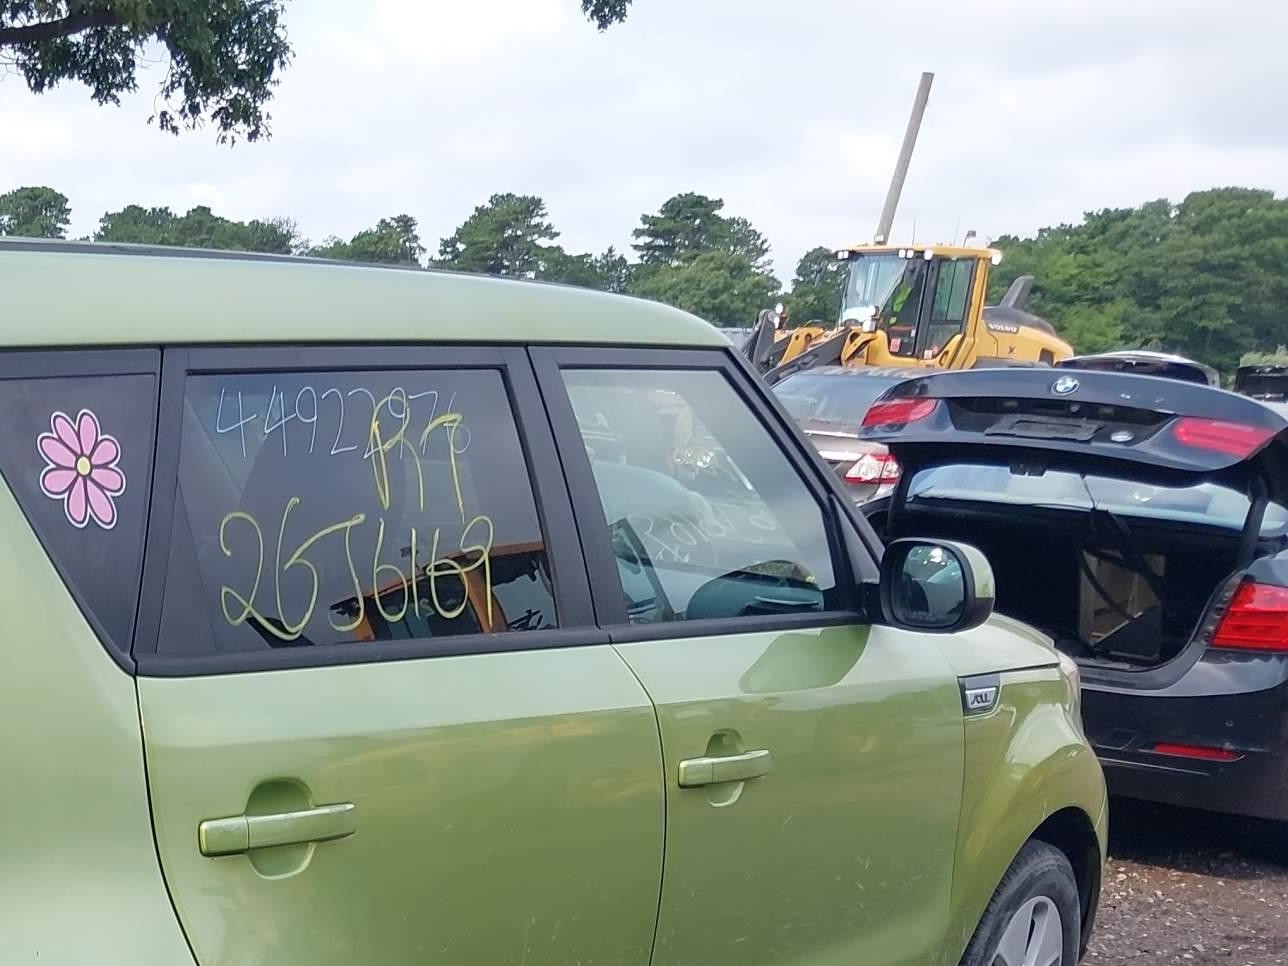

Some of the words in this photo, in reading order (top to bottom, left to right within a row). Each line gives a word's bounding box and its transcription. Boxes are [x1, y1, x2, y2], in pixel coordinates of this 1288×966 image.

[988, 323, 1017, 333] VOLVO
[216, 386, 472, 460] 44922976
[219, 497, 494, 641] 26J6169
